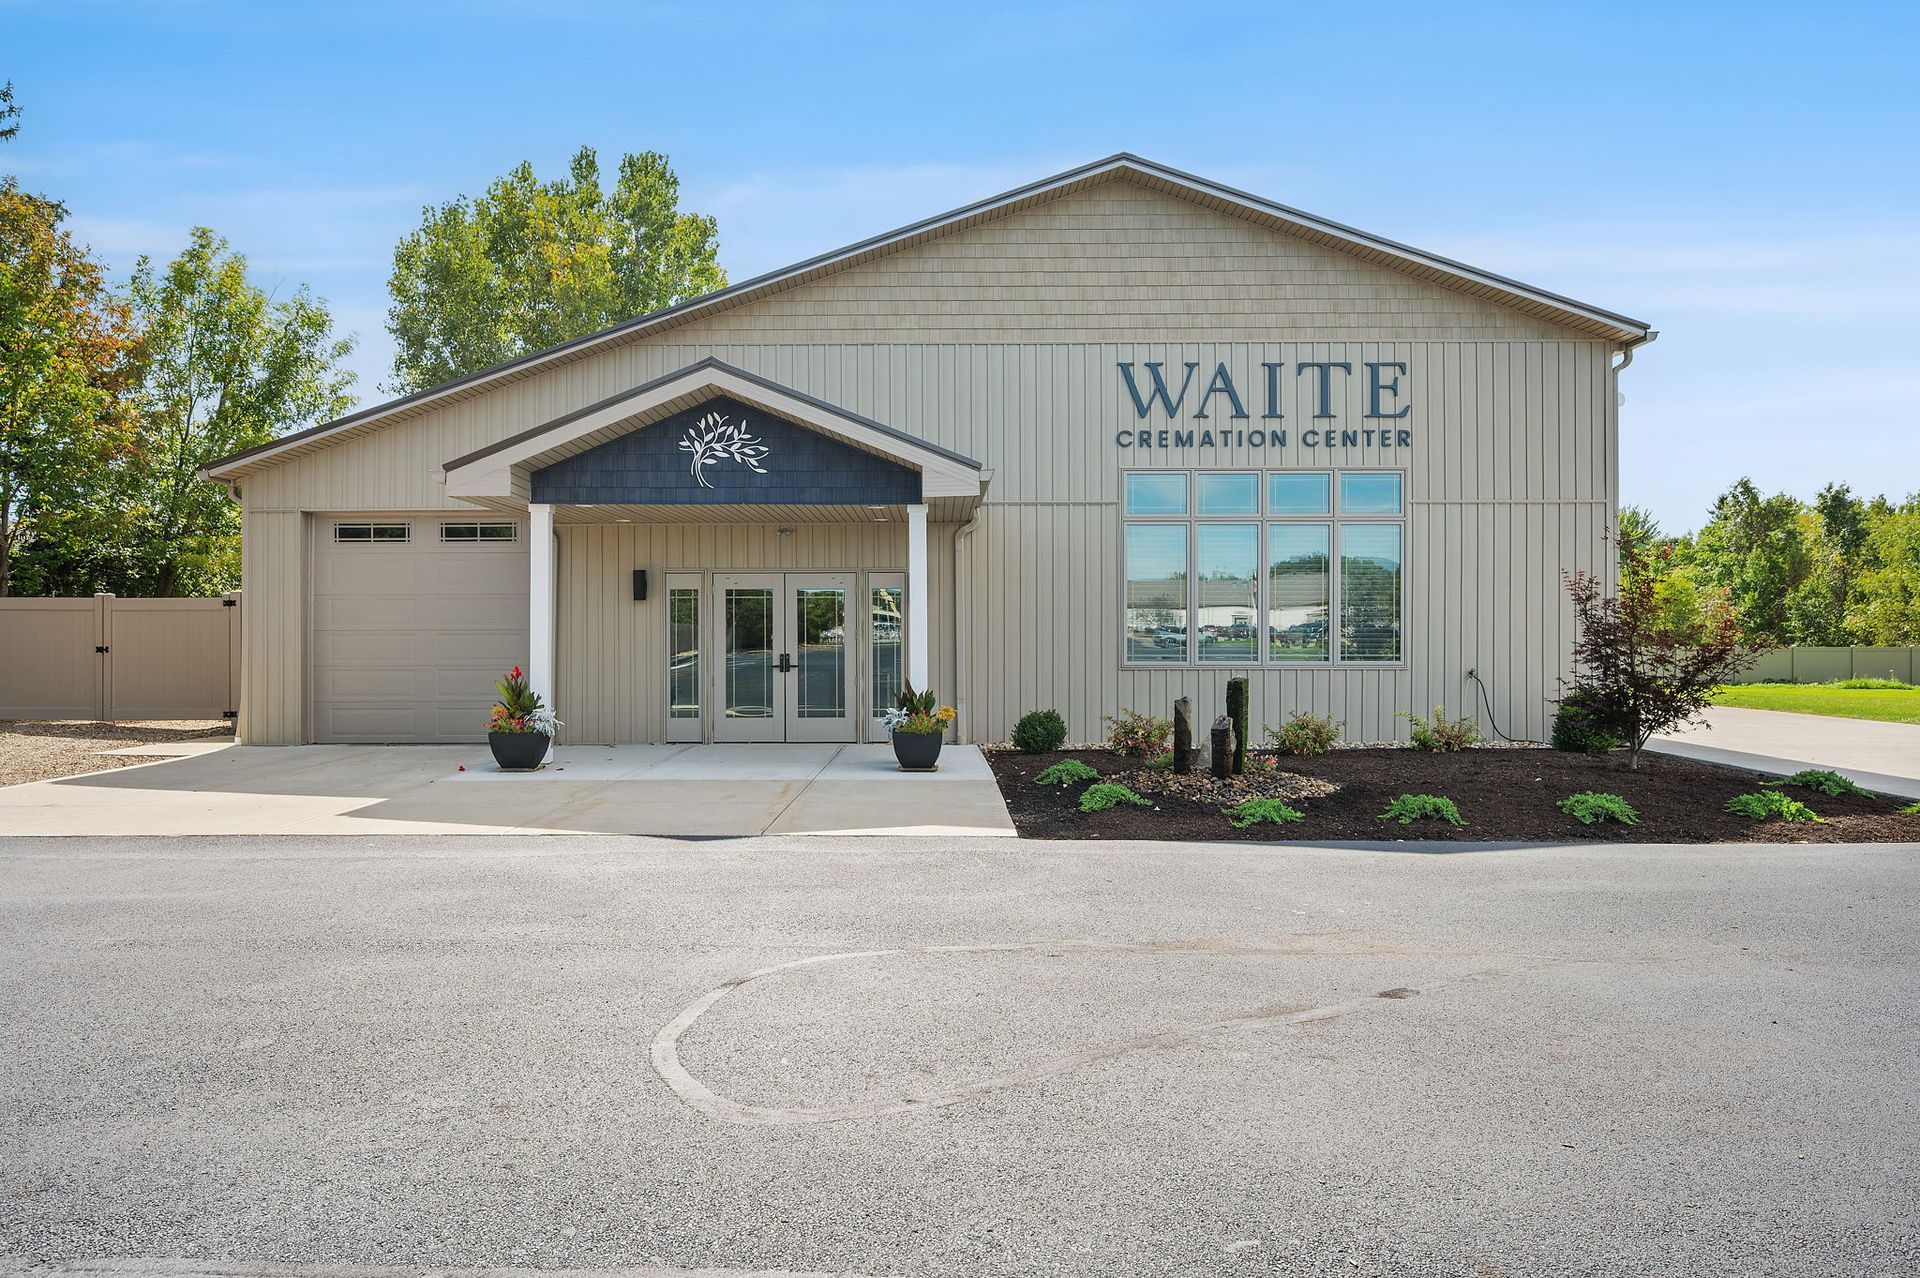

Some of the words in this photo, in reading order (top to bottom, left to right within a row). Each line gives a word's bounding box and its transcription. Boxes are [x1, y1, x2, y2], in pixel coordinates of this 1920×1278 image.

[1117, 361, 1411, 419] WAITE
[1116, 430, 1288, 448] CREMATION
[1302, 430, 1411, 448] CENTER
